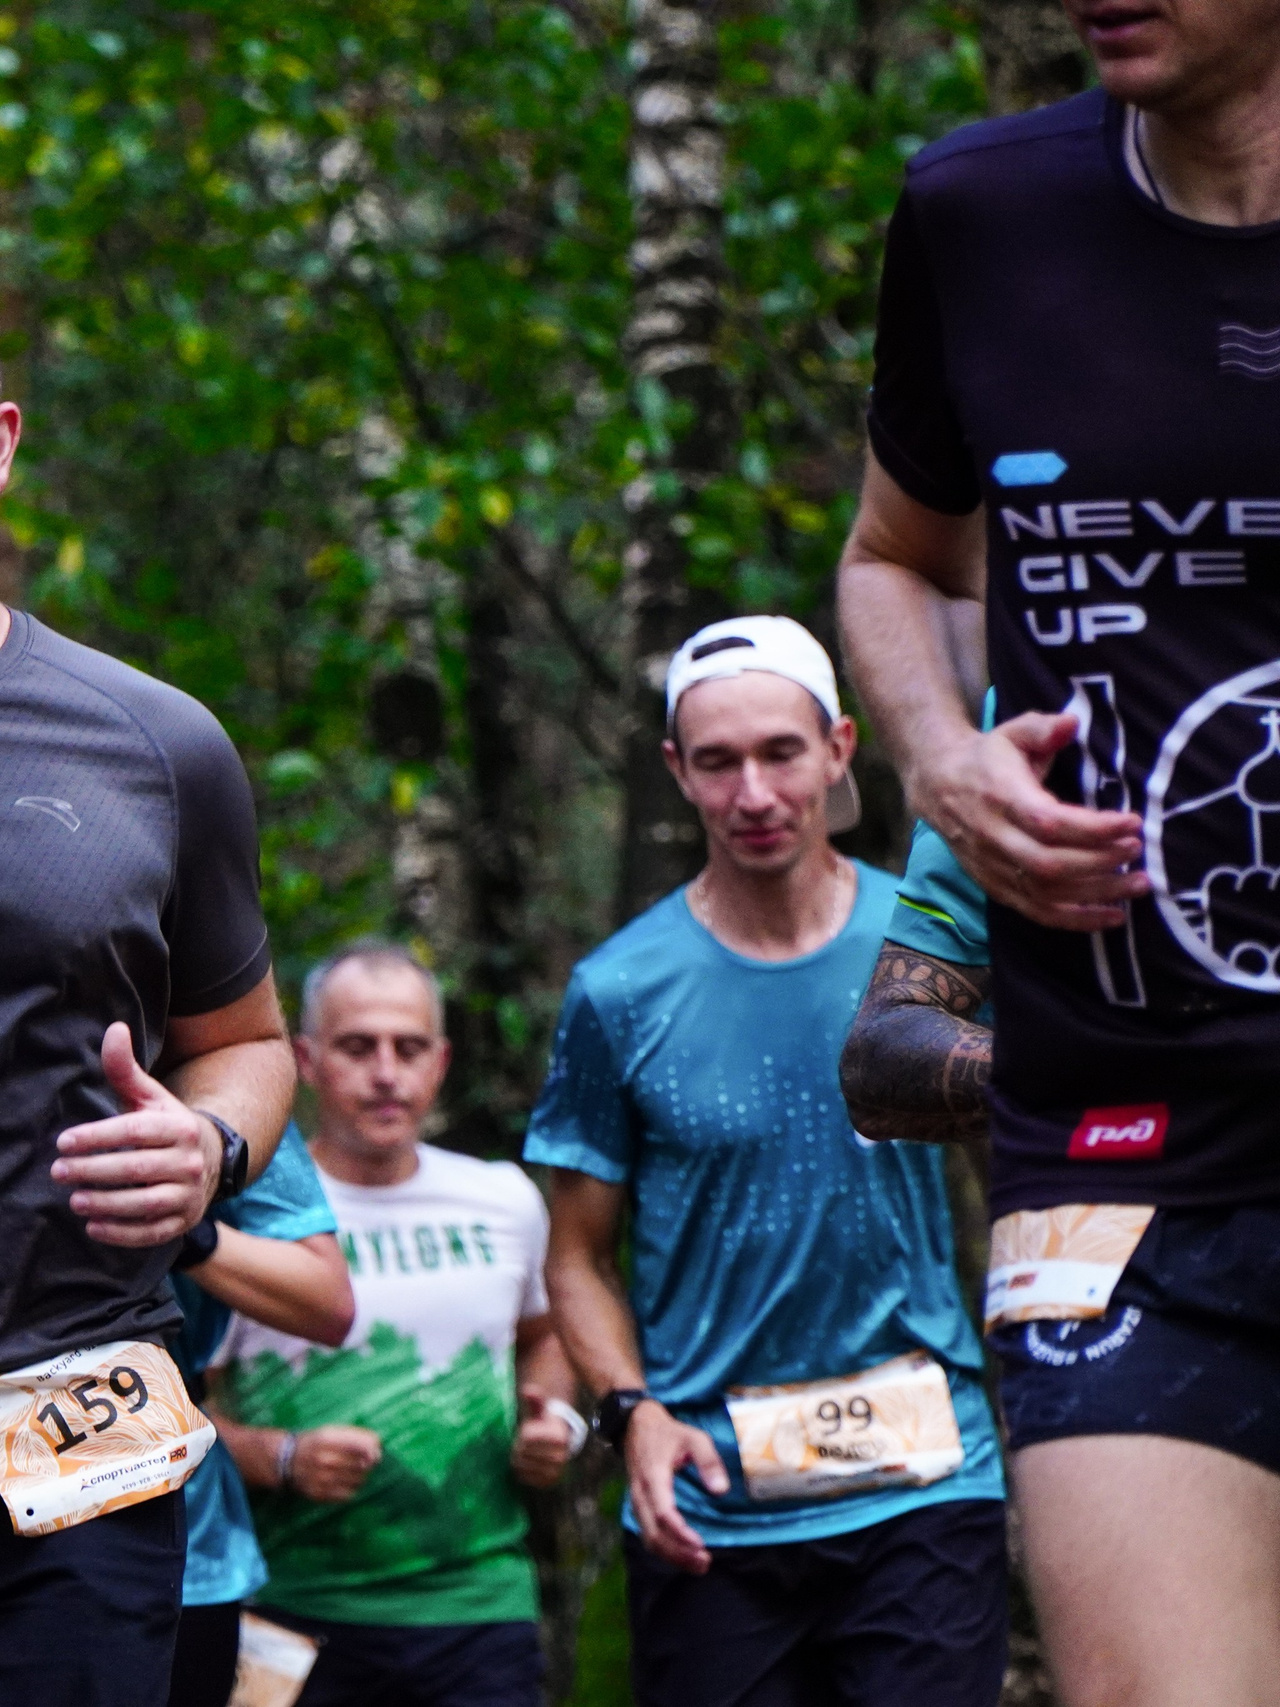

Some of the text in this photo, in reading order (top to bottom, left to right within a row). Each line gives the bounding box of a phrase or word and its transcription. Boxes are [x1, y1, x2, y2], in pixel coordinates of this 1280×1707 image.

[999, 499, 1280, 541] NEVE
[1018, 551, 1247, 594] GIVE
[1023, 603, 1149, 648] UP
[36, 1350, 82, 1383] Backyard
[36, 1366, 149, 1455] 159
[817, 1394, 872, 1436] 99
[169, 1446, 188, 1461] PRO
